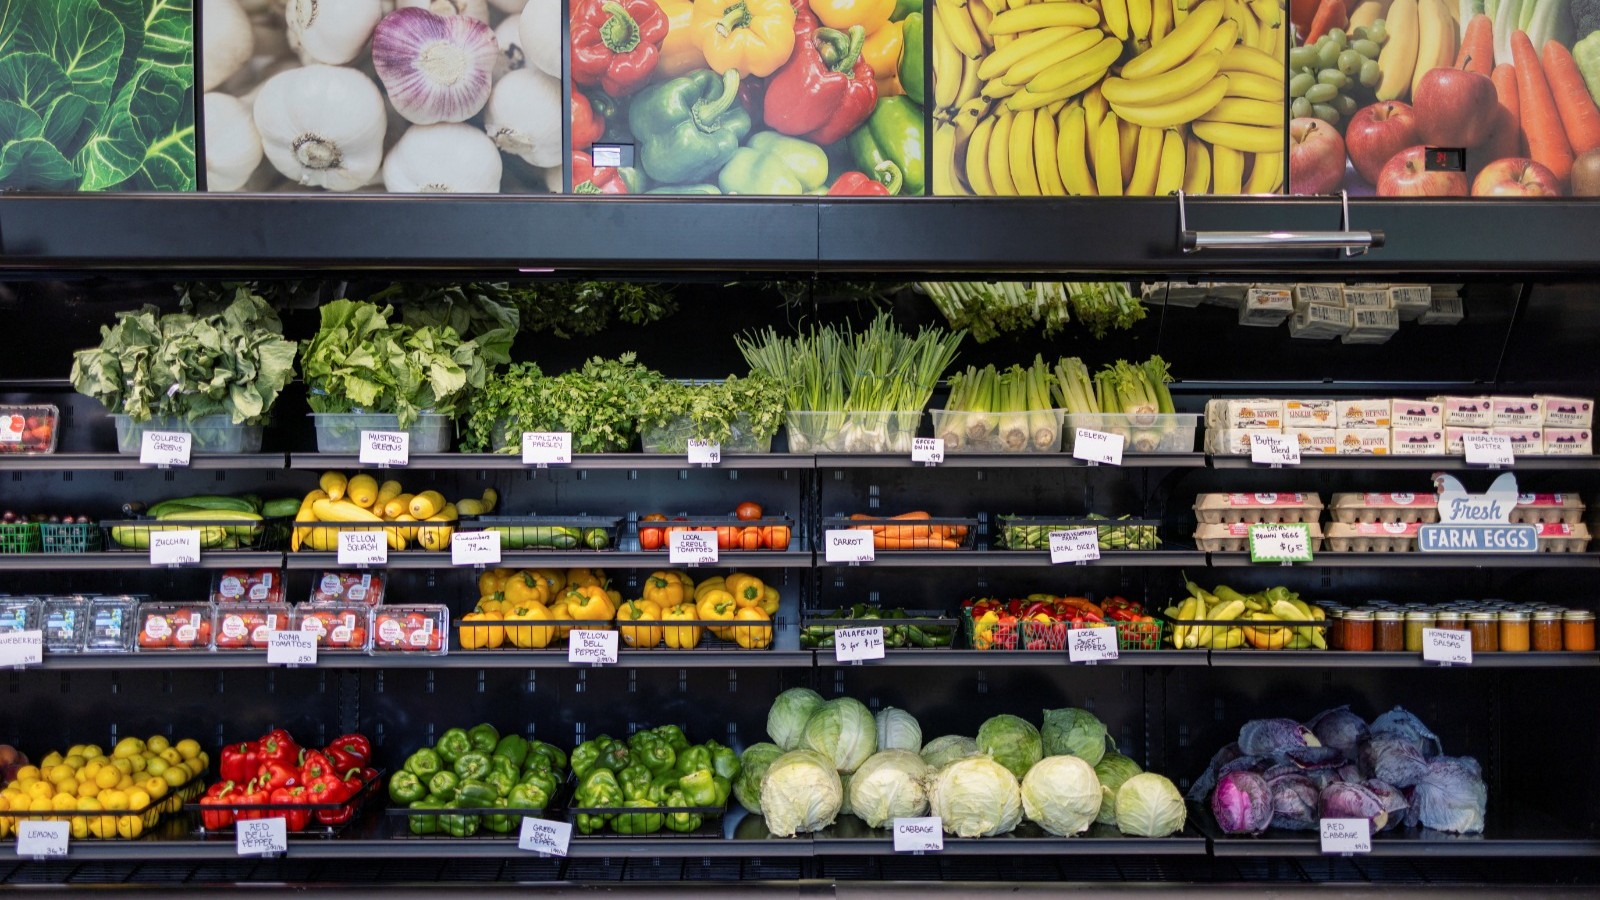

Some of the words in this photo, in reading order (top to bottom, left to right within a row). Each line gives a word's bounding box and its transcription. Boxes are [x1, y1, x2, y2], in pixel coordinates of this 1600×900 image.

[150, 434, 186, 444] COLLARD
[368, 433, 403, 444] MUSTARD
[1078, 430, 1108, 442] CELERY
[1253, 434, 1282, 446] Butter
[1467, 435, 1505, 443] UNSALTED
[532, 441, 563, 449] PARSLEY
[1270, 445, 1290, 454] Blend
[1450, 497, 1502, 521] Fresh
[155, 538, 190, 547] ZUCCHINI
[345, 534, 376, 543] YELLOW
[833, 537, 864, 546] CARROT
[1428, 529, 1478, 548] FARM
[1484, 529, 1529, 548] EGGS
[346, 543, 378, 552] SQUASH
[675, 546, 714, 554] TOMATOES
[1052, 545, 1074, 553] LOCAL
[1076, 543, 1096, 551] OKRA
[278, 632, 300, 641] ROMA
[578, 631, 609, 640] YELLOW
[838, 628, 878, 638] JALAPENO
[1428, 630, 1465, 642] HOMEMADE
[270, 640, 312, 649] TOMATOES
[583, 639, 604, 648] BELL
[1076, 637, 1102, 646] SWEET
[1433, 639, 1461, 649] SALSAS
[840, 643, 847, 651] 3
[850, 642, 860, 653] for
[1074, 644, 1107, 652] PEPPERS
[575, 648, 607, 657] PEPPER
[249, 823, 270, 832] RED
[532, 823, 557, 835] GREEN
[899, 825, 934, 834] CABBAGE
[1327, 823, 1345, 831] RED
[27, 831, 59, 840] LEMONS
[245, 831, 274, 840] BELL
[534, 832, 553, 841] BELL
[1322, 831, 1359, 839] CABBAGE
[242, 838, 273, 848] PEPPER
[529, 836, 557, 847] PEPPER
